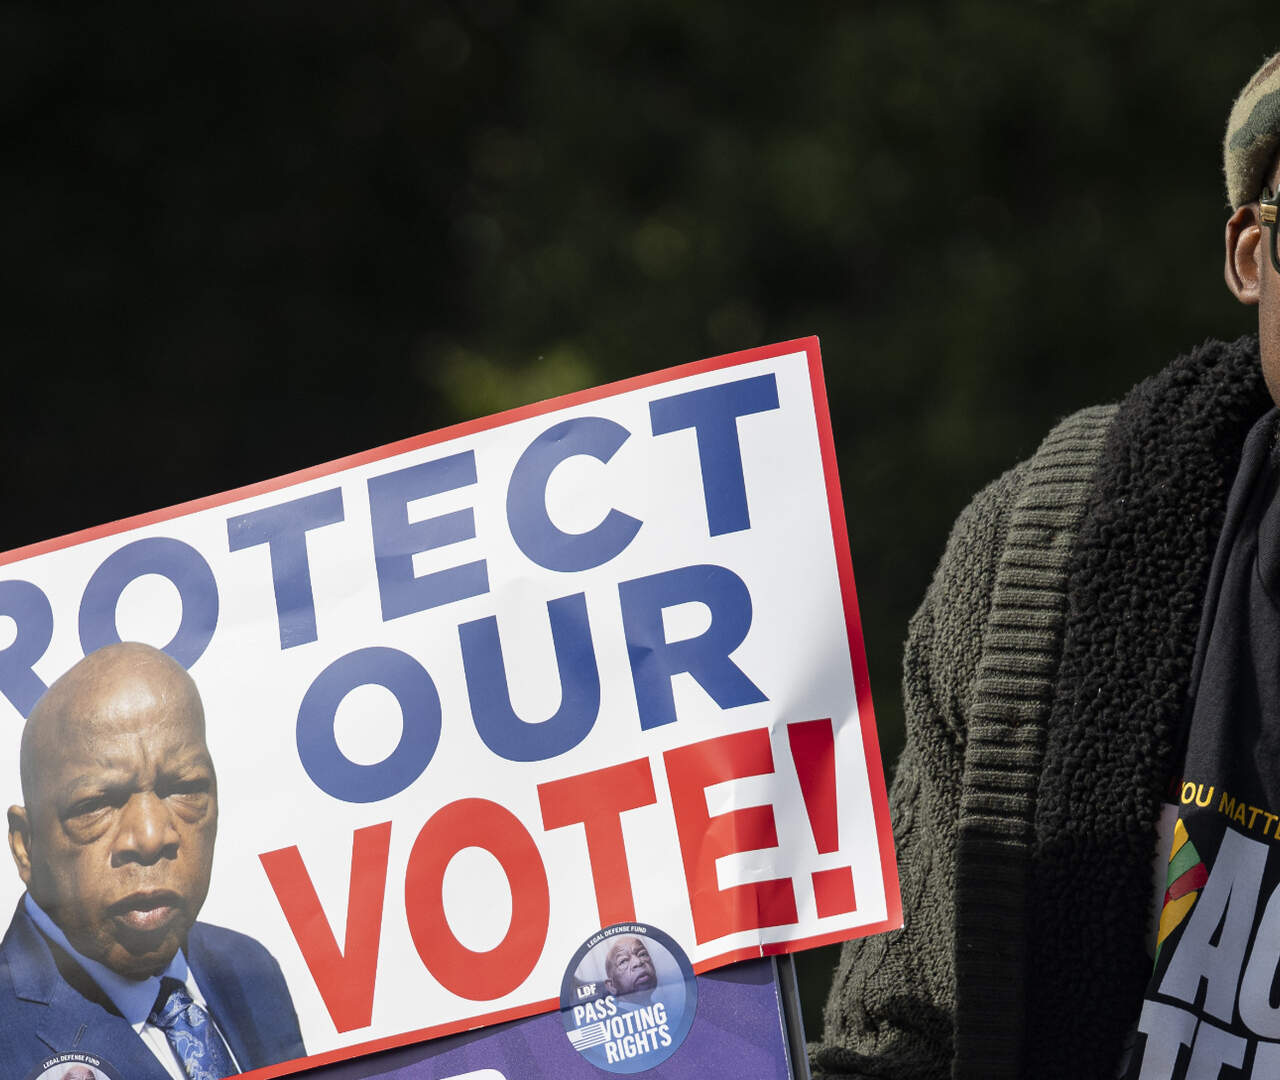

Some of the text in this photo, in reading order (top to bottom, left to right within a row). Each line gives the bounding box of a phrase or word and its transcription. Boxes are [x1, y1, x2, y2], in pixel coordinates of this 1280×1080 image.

[295, 564, 770, 803] OUR
[1180, 781, 1215, 807] OU
[257, 718, 858, 1034] VOTE!
[586, 925, 647, 949] LEGAL DEFENSE FUND
[577, 984, 597, 998] LDF
[573, 995, 617, 1026] PASS
[601, 1002, 668, 1041] VOTING
[604, 1024, 672, 1064] RIGHTS
[43, 1054, 101, 1069] LEGAL DEFENSE FUND
